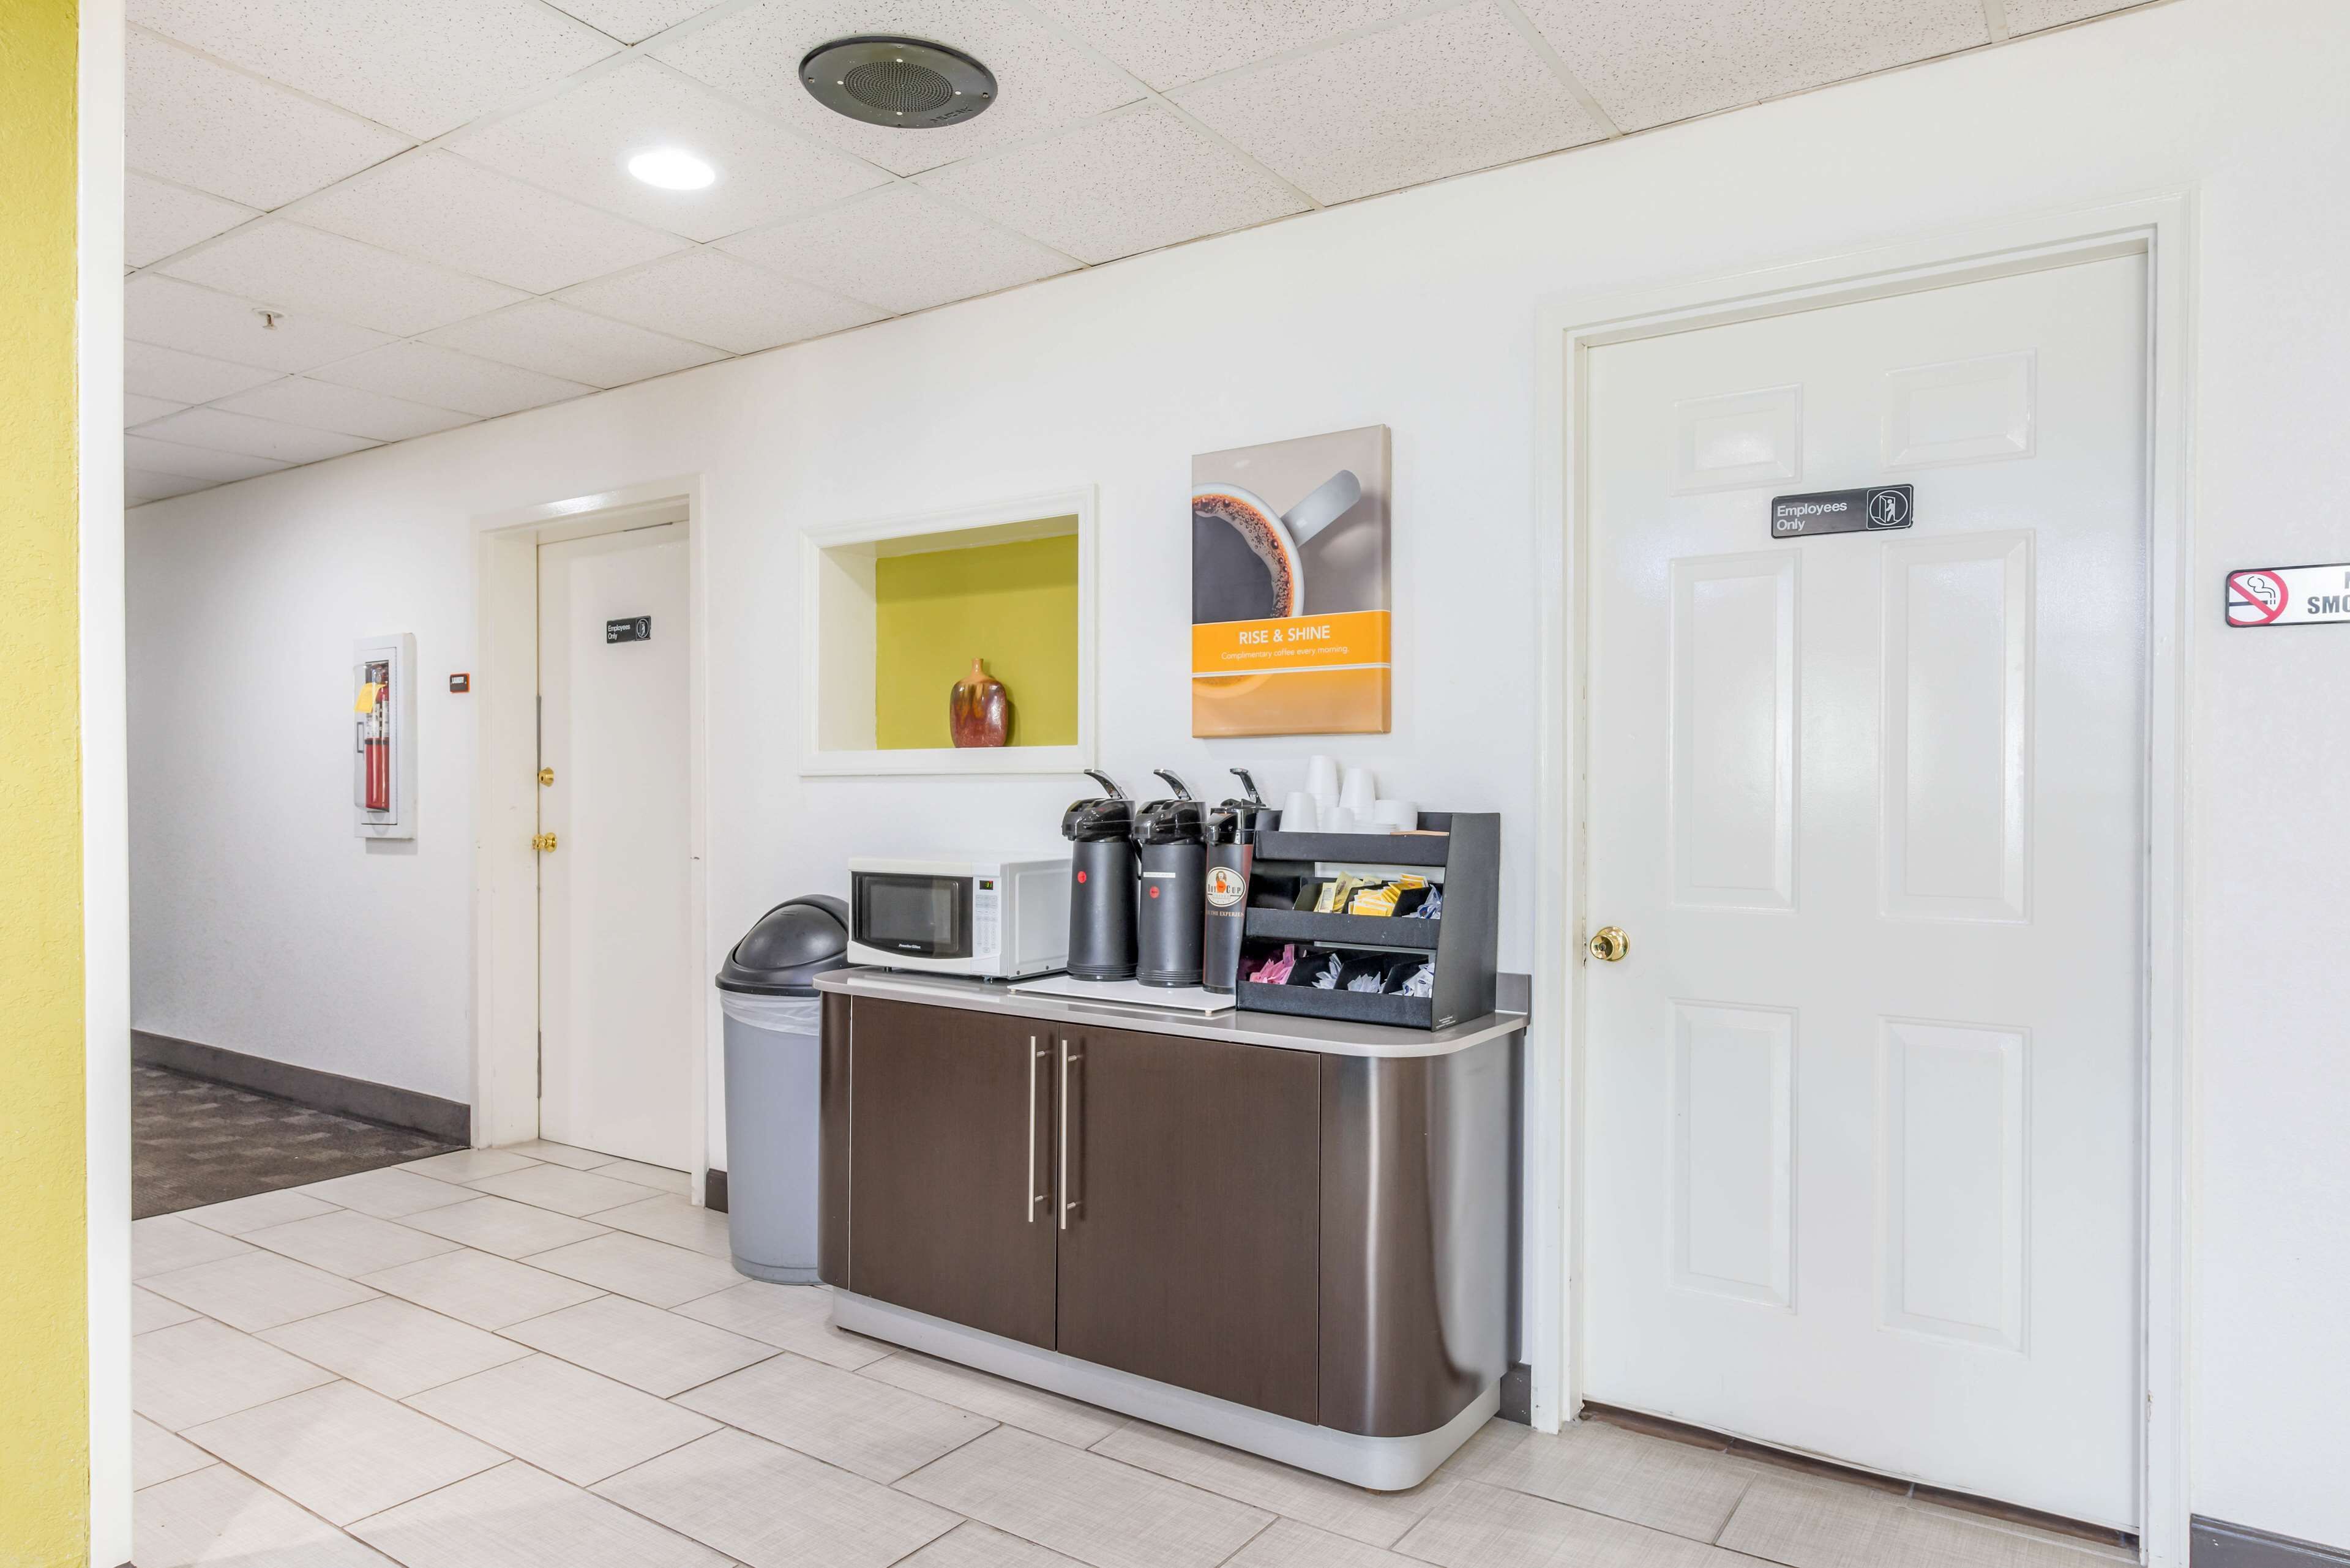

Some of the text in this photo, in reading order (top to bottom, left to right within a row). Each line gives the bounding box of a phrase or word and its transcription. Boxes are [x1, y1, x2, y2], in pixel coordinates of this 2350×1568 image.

[1777, 501, 1847, 517] Employees
[1776, 518, 1805, 531] Only
[1240, 625, 1330, 644] RISE & SHINE
[1221, 650, 1272, 661] Complimentary
[1273, 648, 1295, 657] coffee
[1297, 648, 1316, 656] every
